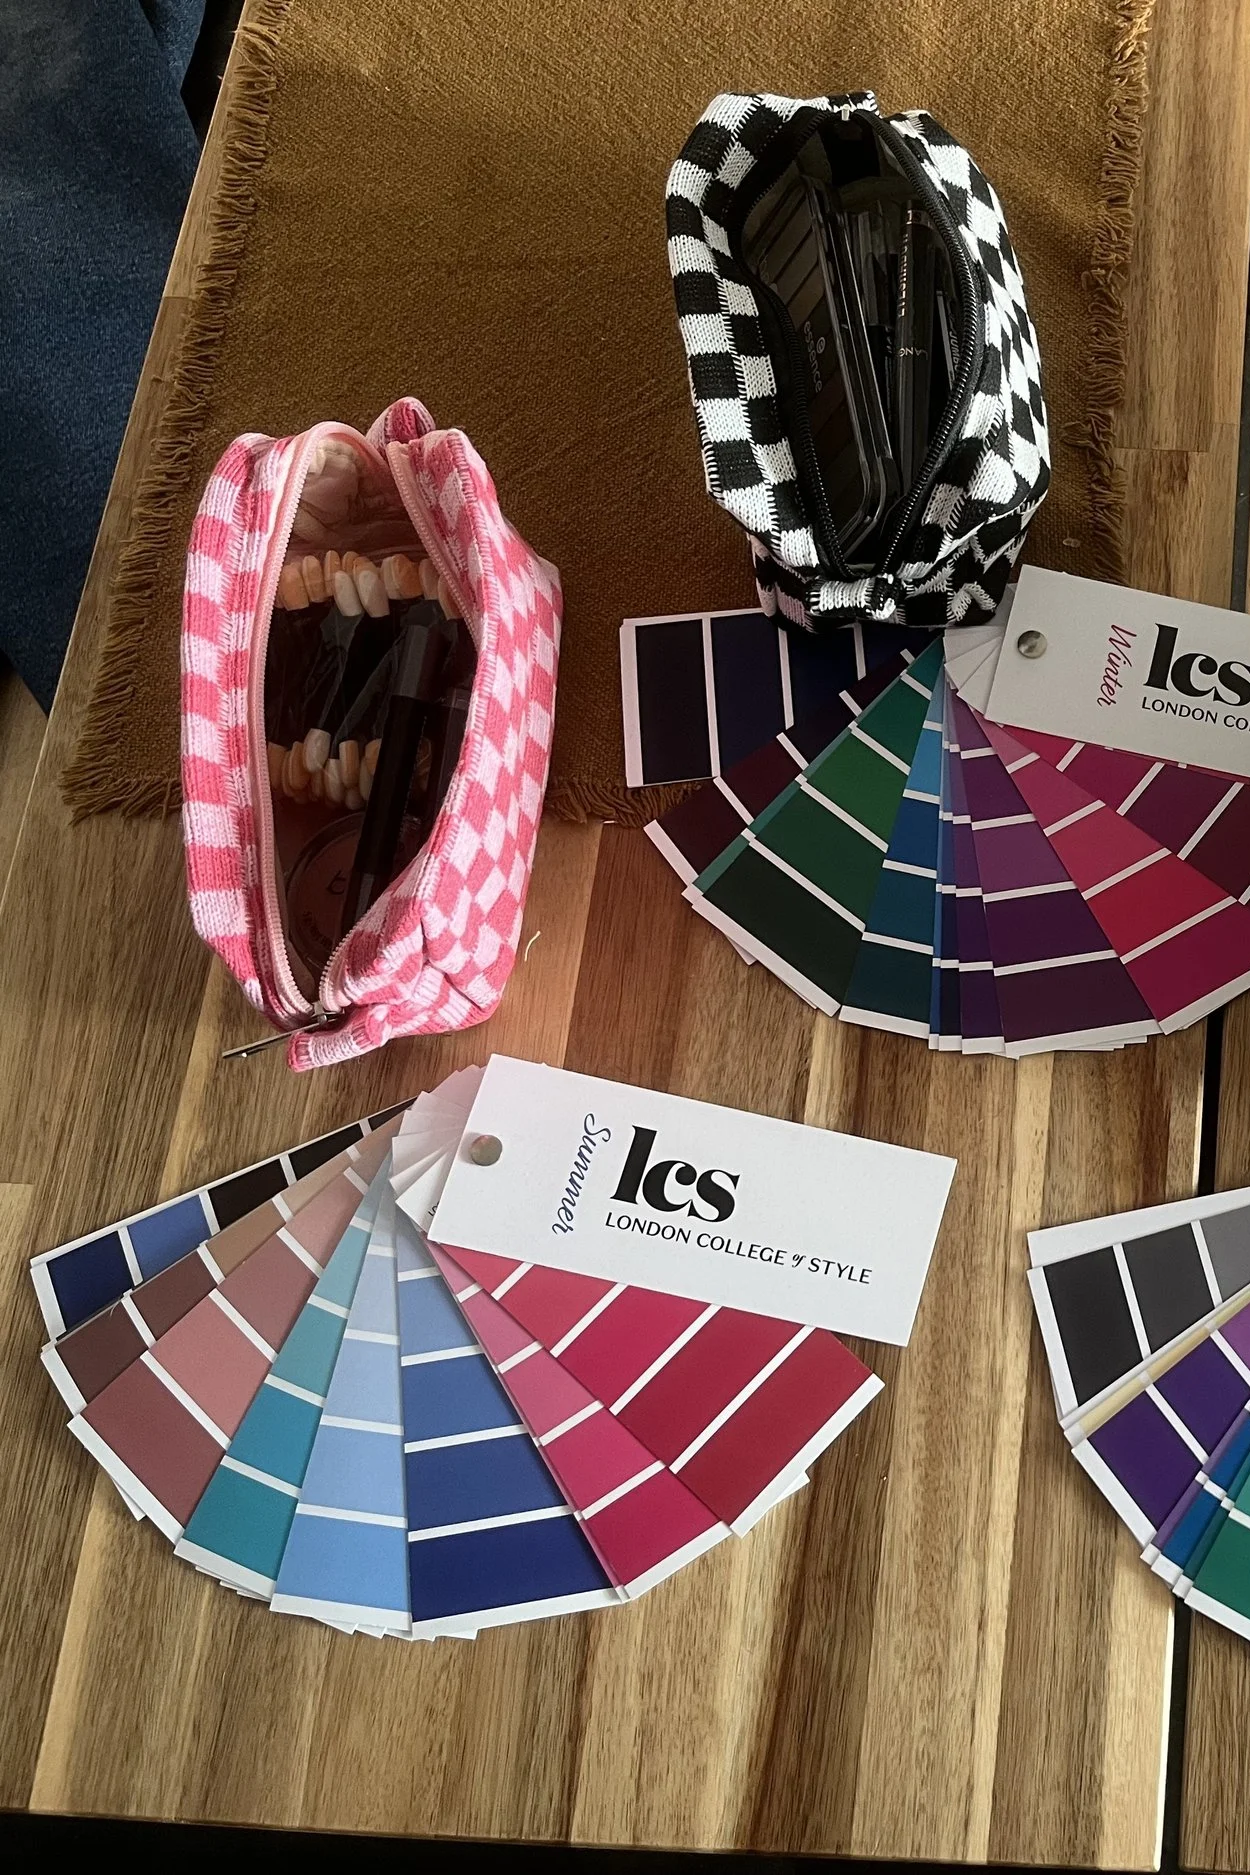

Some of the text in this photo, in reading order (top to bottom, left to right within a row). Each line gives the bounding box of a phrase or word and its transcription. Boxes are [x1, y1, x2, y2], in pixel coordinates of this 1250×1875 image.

[803, 320, 823, 393] essence
[1097, 624, 1137, 707] Winter
[1141, 696, 1219, 725] LONDON
[552, 1113, 611, 1235] Summer
[605, 1211, 873, 1285] LONDON COLLEGE of STYLE
